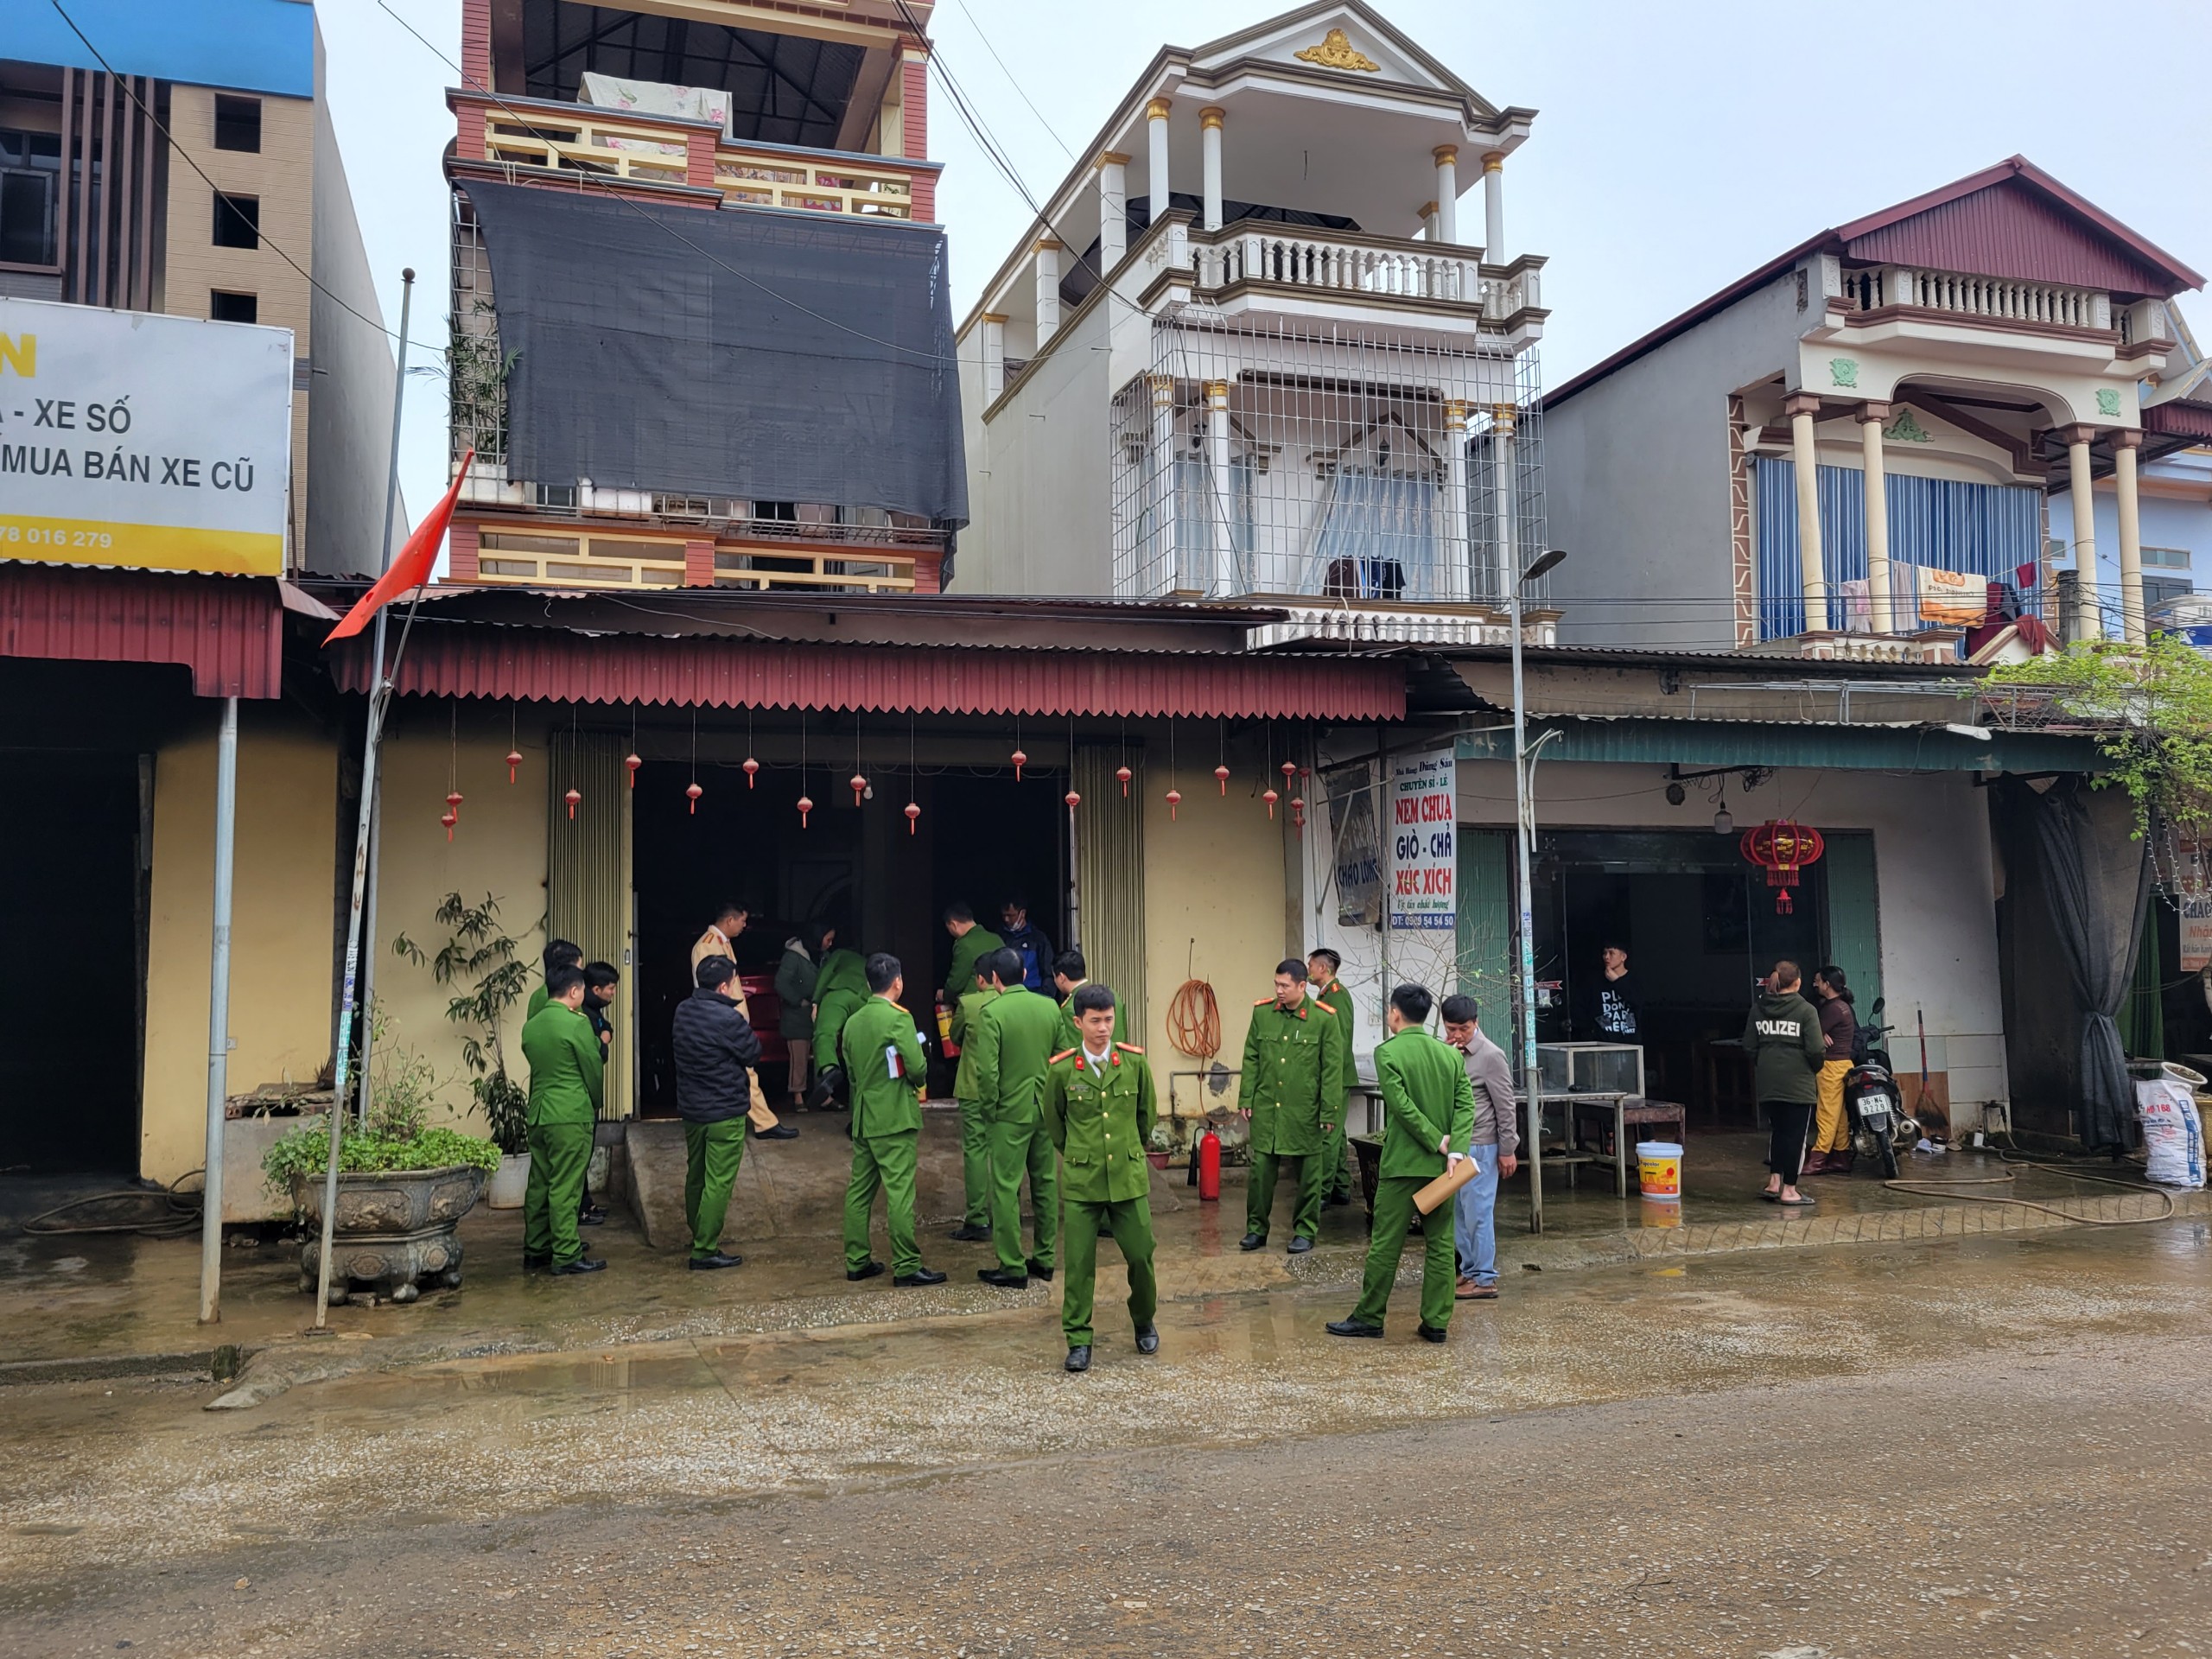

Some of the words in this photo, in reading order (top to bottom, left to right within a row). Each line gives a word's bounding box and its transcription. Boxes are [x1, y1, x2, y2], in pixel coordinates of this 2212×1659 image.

[34, 397, 76, 429] XE
[86, 395, 131, 434] SỐ
[2, 444, 73, 477] MUA
[84, 446, 149, 483] BÁN
[161, 456, 200, 487] XE
[211, 457, 254, 492] CŨ
[27, 528, 67, 545] 016
[73, 531, 112, 549] 279
[1395, 797, 1419, 825] NEM
[1421, 792, 1452, 823] CHUA
[1396, 829, 1419, 860] GIÒ
[1431, 822, 1452, 858] CHẢ
[1338, 859, 1359, 889] CHÁO
[1395, 863, 1420, 895] XÚC
[1423, 861, 1452, 896] XÍCH
[1423, 916, 1432, 926] 54
[1434, 916, 1443, 926] 54
[1445, 916, 1453, 926] 50
[1756, 1020, 1800, 1037] POLIZEI
[1864, 1103, 1885, 1114] 9229
